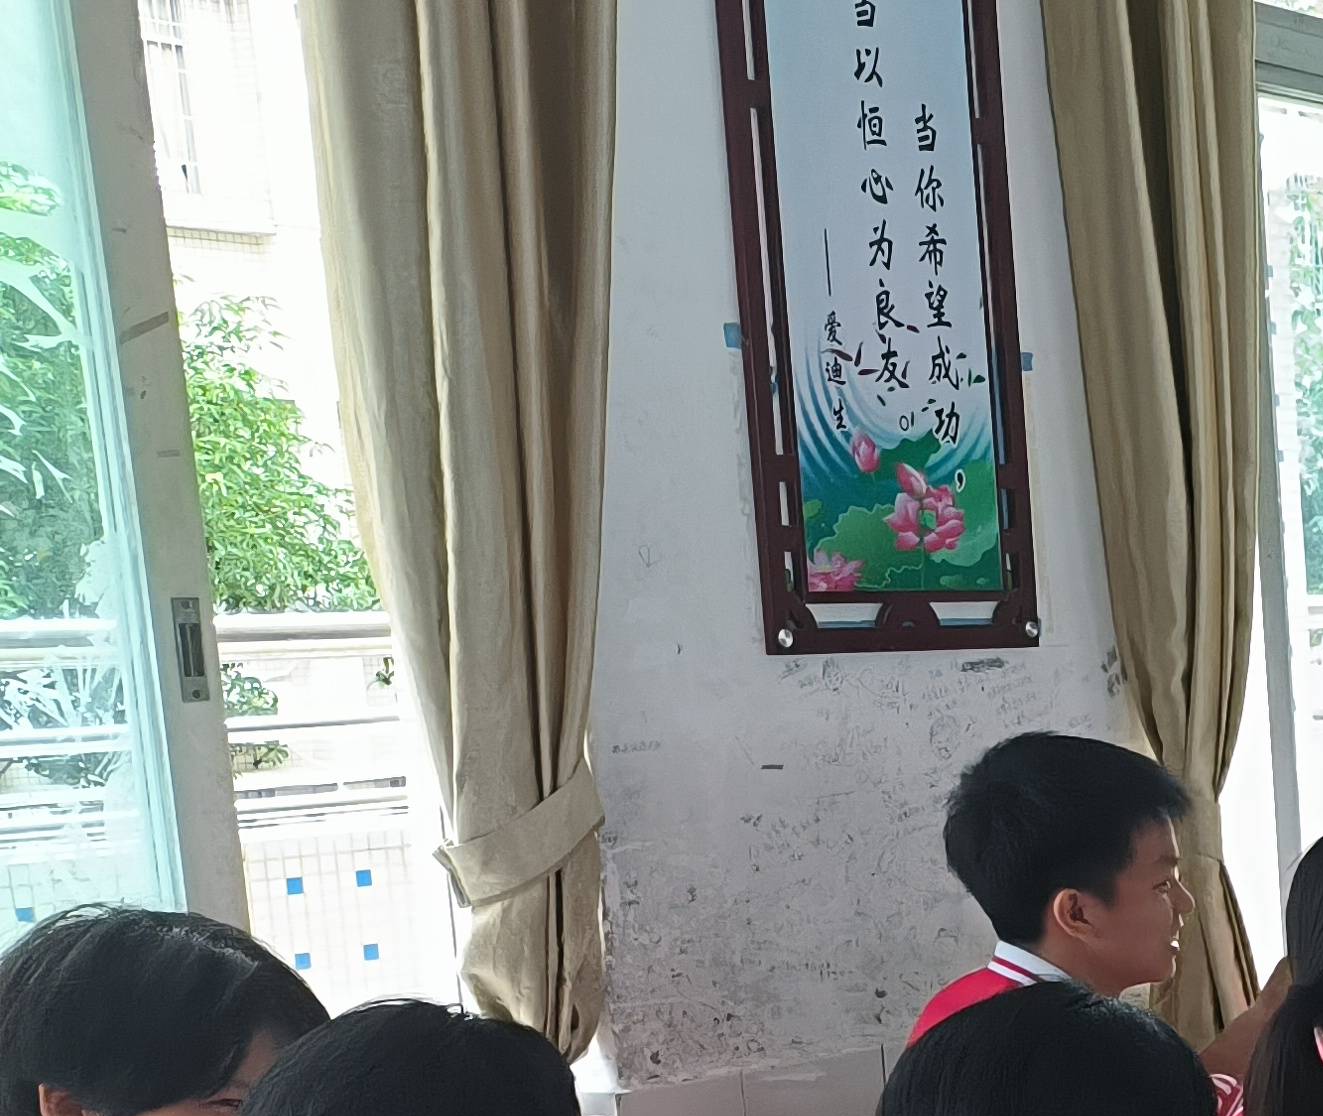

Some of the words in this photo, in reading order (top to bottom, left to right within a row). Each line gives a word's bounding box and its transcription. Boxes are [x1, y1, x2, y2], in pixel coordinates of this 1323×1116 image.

[913, 103, 966, 492] 当你希望成功，
